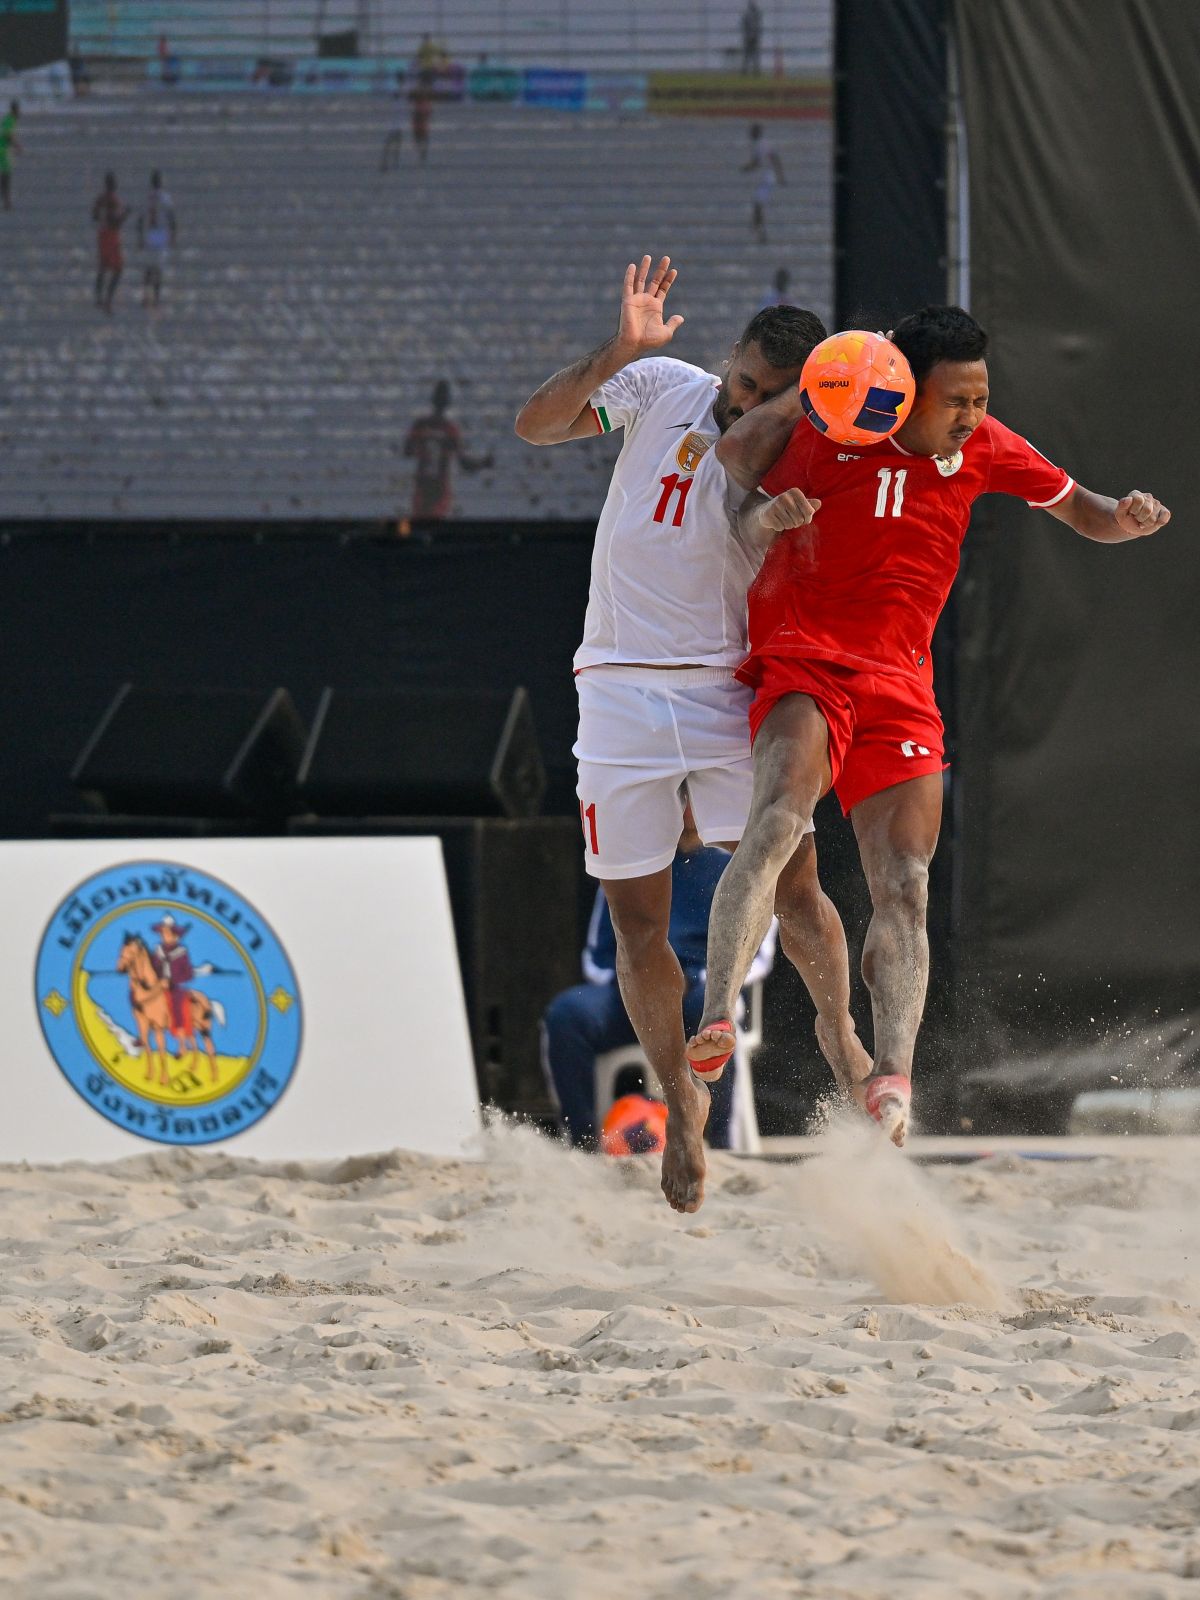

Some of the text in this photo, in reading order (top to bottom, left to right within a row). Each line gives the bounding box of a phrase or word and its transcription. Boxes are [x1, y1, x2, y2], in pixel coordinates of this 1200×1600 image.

[819, 380, 850, 389] molten
[653, 472, 694, 527] 11
[874, 467, 908, 518] 11
[57, 868, 264, 950] เมืองพัทยา
